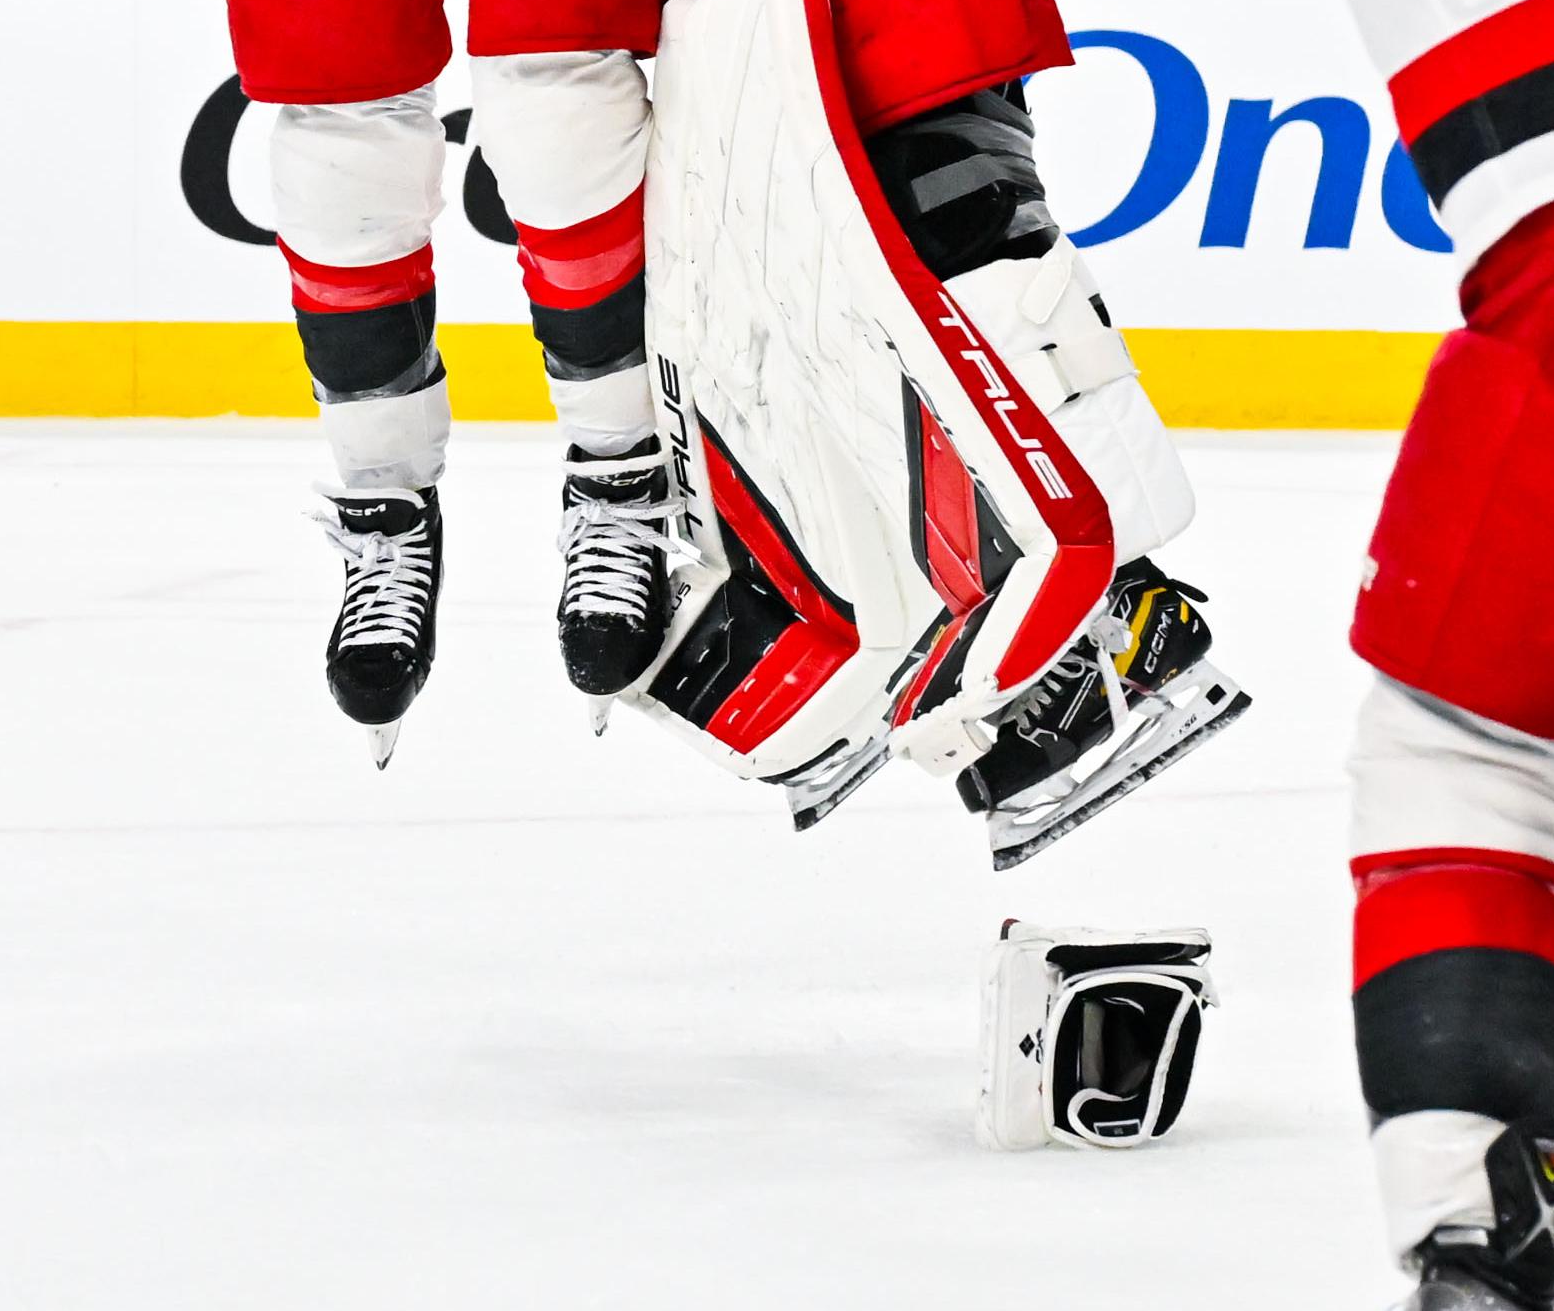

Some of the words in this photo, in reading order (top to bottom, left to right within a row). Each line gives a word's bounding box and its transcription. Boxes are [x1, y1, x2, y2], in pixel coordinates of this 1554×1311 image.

[656, 351, 704, 541] TRUE
[936, 290, 1074, 501] TRUE
[1143, 606, 1176, 675] CCM
